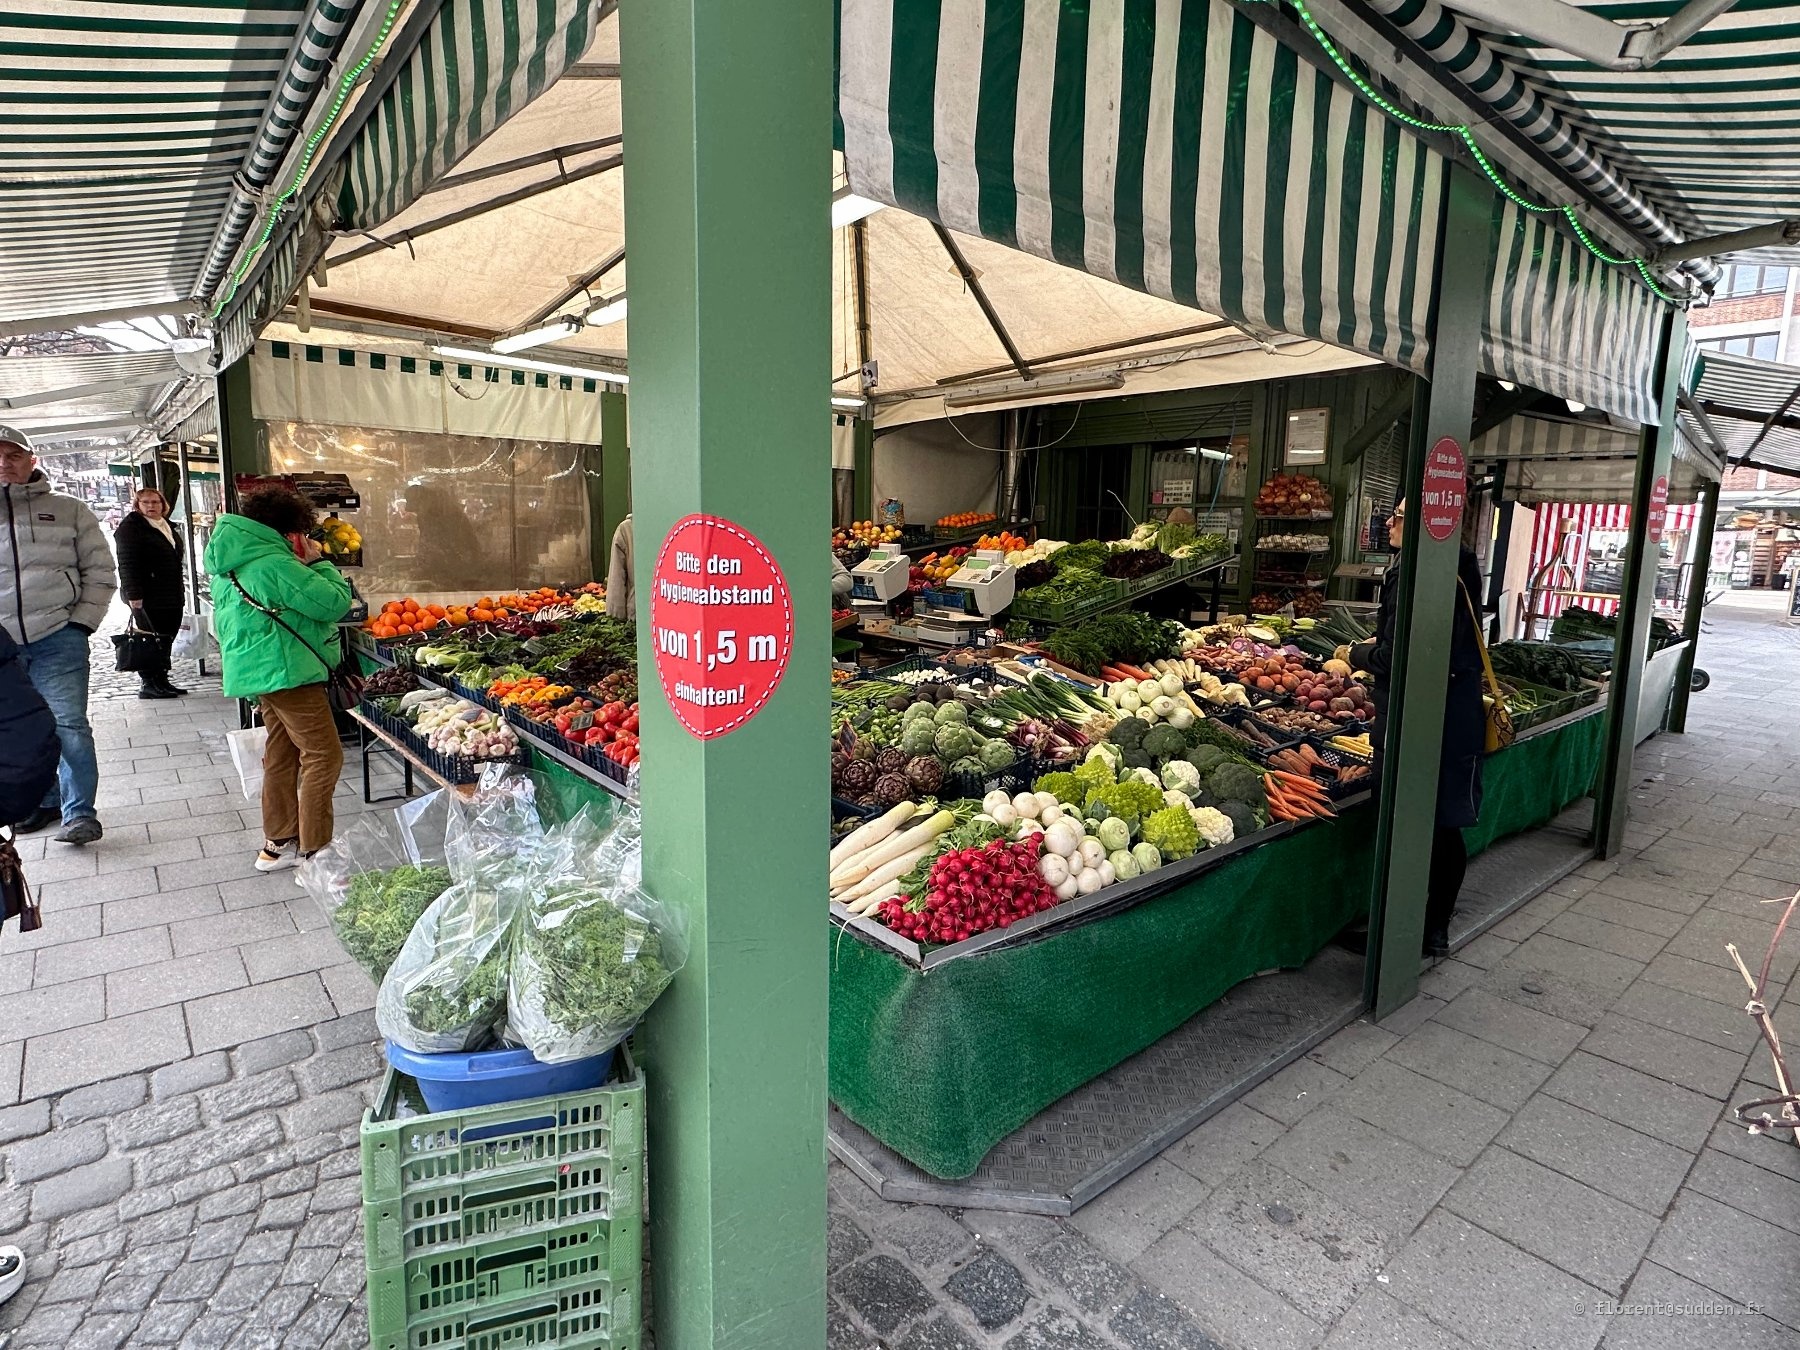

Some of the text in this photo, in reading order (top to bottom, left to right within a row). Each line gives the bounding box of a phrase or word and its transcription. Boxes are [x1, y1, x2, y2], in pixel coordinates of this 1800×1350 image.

[1425, 490, 1462, 509] von 1,5 m
[676, 551, 742, 575] Bitte den
[660, 578, 773, 605] Hygieneabstand
[658, 627, 777, 671] von 1,5 m
[675, 680, 745, 707] einhalten!
